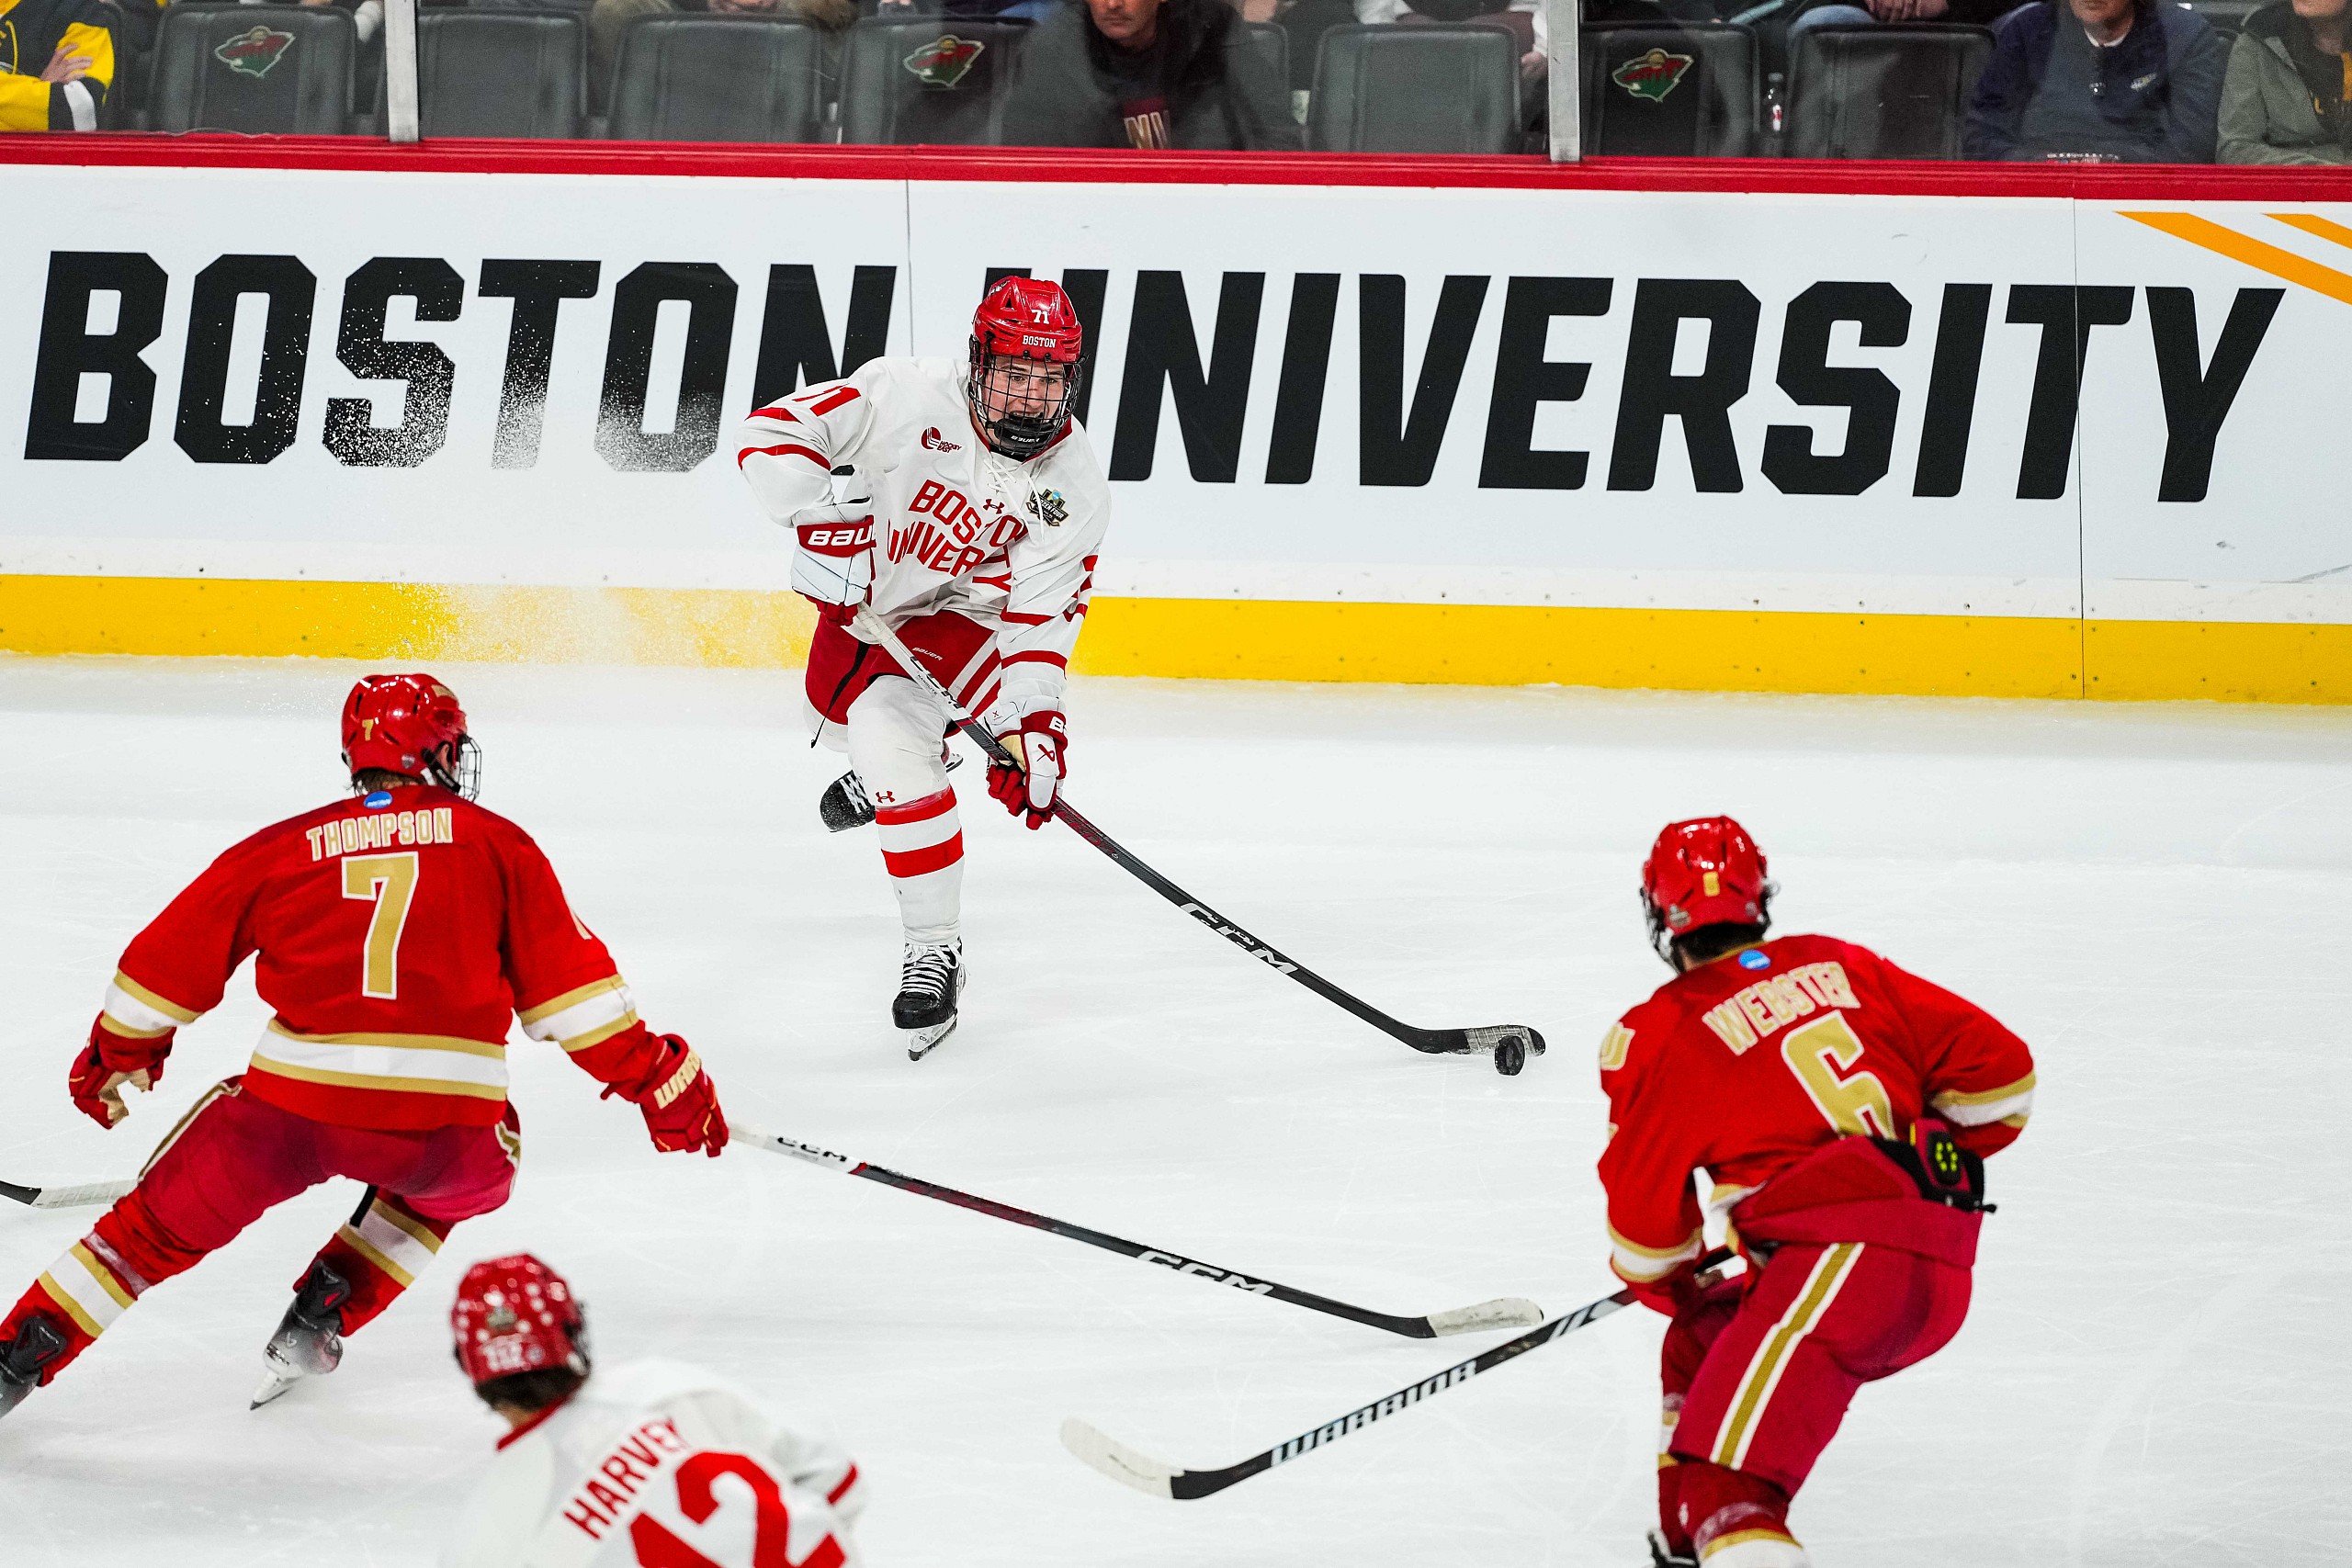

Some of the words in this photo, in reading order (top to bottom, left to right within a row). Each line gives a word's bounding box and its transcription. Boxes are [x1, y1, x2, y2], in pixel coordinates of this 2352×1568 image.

[1022, 334, 1057, 348] BOSTON
[1031, 309, 1049, 324] 71
[24, 251, 897, 475] BOSTON
[808, 525, 876, 546] BAU
[362, 719, 374, 740] 7
[306, 807, 453, 862] THOMPSON
[341, 852, 419, 999] 7
[1180, 903, 1299, 975] CCM
[1702, 962, 1861, 1055] WEBSTER
[1781, 1010, 1898, 1141] 6
[1136, 1250, 1273, 1295] CCM
[1271, 1359, 1476, 1467] WARRIOR
